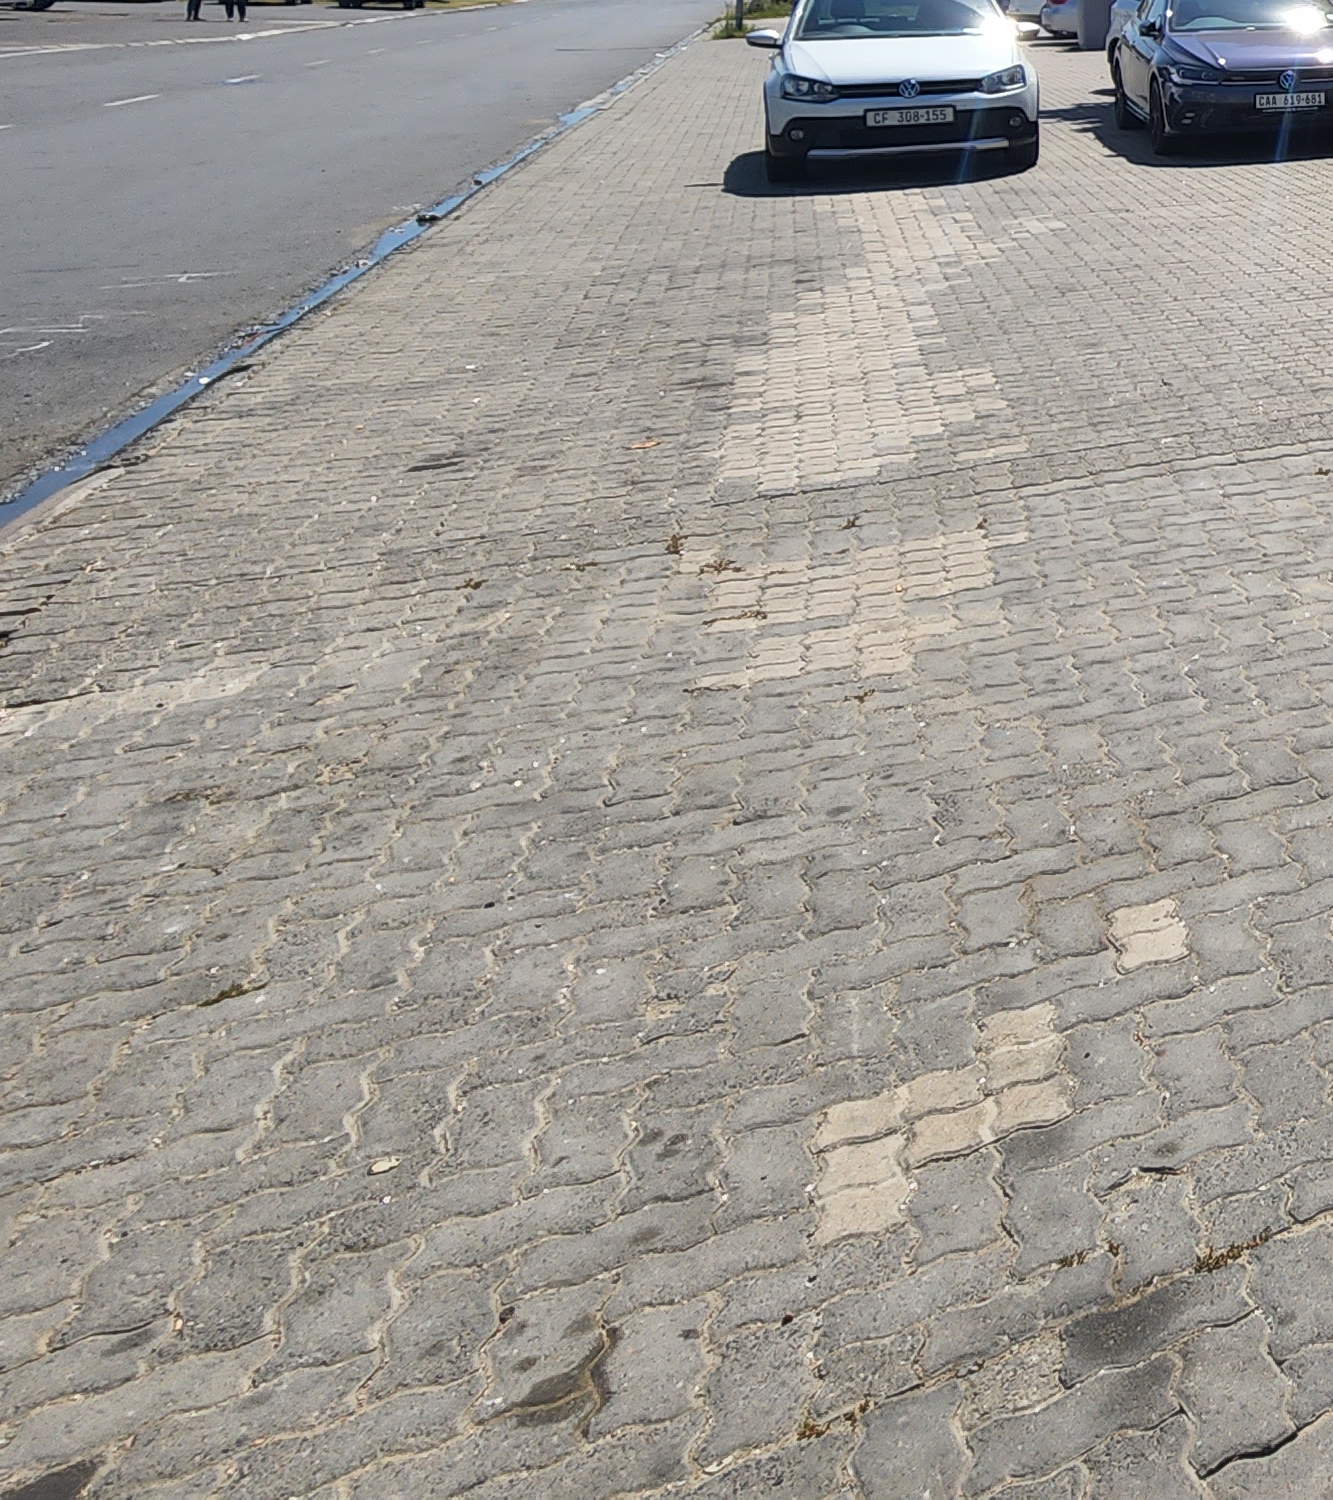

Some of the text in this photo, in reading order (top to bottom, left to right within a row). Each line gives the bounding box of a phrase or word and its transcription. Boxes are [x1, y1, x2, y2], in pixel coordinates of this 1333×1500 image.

[1259, 95, 1277, 107] CAA
[873, 109, 947, 125] CF 308-155
